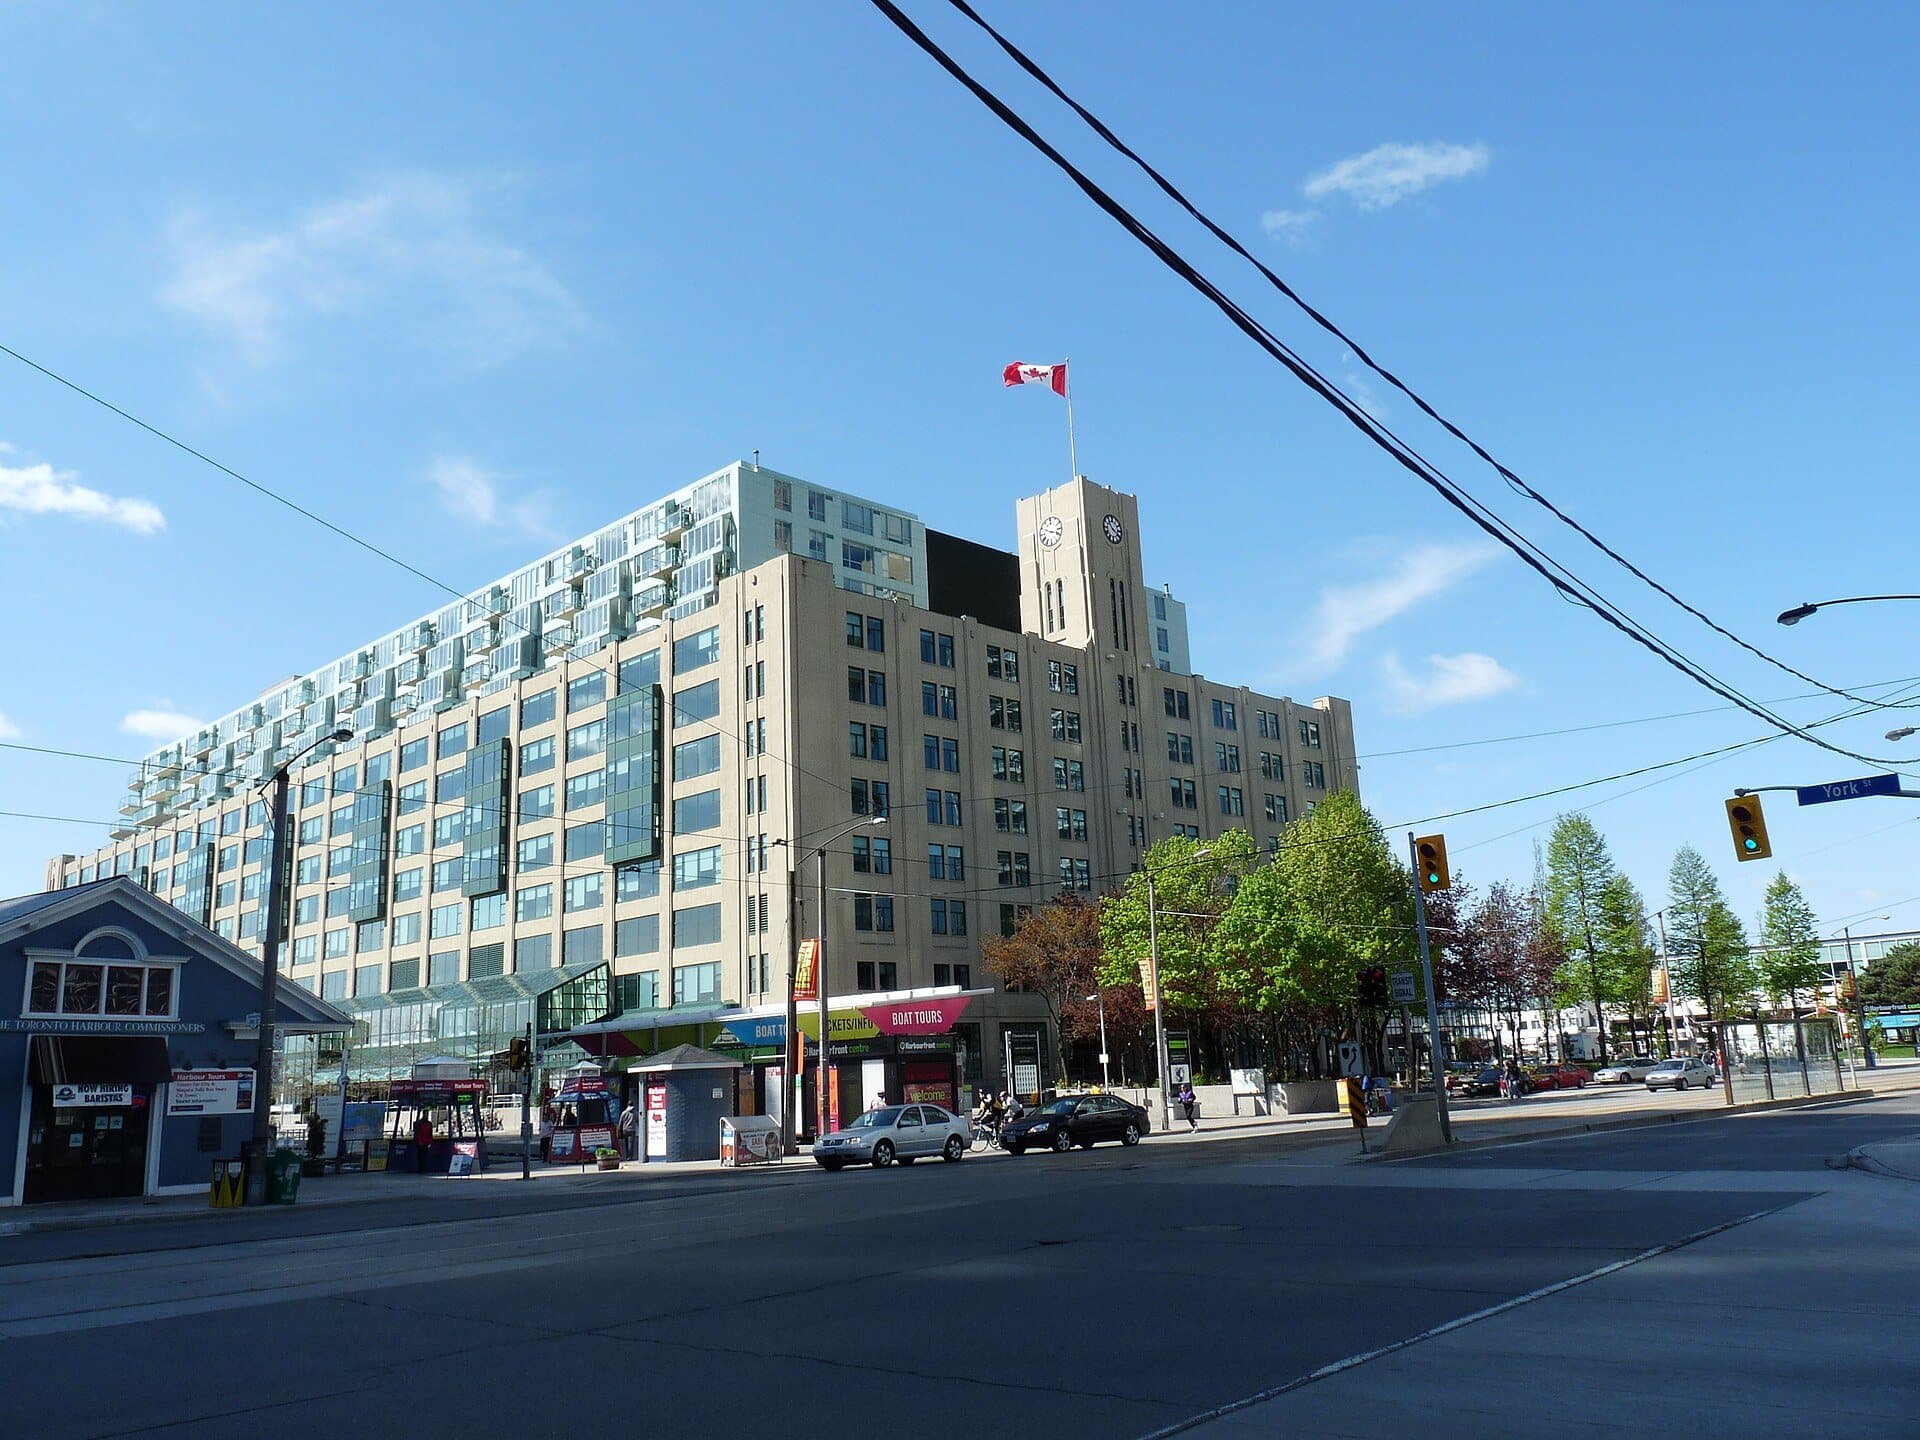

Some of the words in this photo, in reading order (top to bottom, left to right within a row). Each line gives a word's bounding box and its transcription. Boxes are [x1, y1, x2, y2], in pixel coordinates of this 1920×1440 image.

[1822, 781, 1860, 798] York
[1863, 779, 1872, 787] St
[828, 1017, 873, 1031] CKETS/INFO
[892, 1011, 913, 1025] BOAT
[914, 1010, 943, 1024] TOURS
[16, 1020, 68, 1031] TORONTO
[71, 1021, 121, 1032] HARBOUR
[125, 1022, 206, 1033] COMMISSIONERS
[755, 1024, 776, 1038] BOAT
[808, 1045, 848, 1057] Harrfront
[848, 1044, 870, 1054] centre
[905, 1041, 936, 1049] Harbourfront
[177, 1073, 206, 1081] Harbour
[78, 1083, 98, 1093] NOW
[100, 1083, 129, 1093] HIRING
[85, 1094, 123, 1103] BARISTAS
[910, 1089, 946, 1102] welcome
